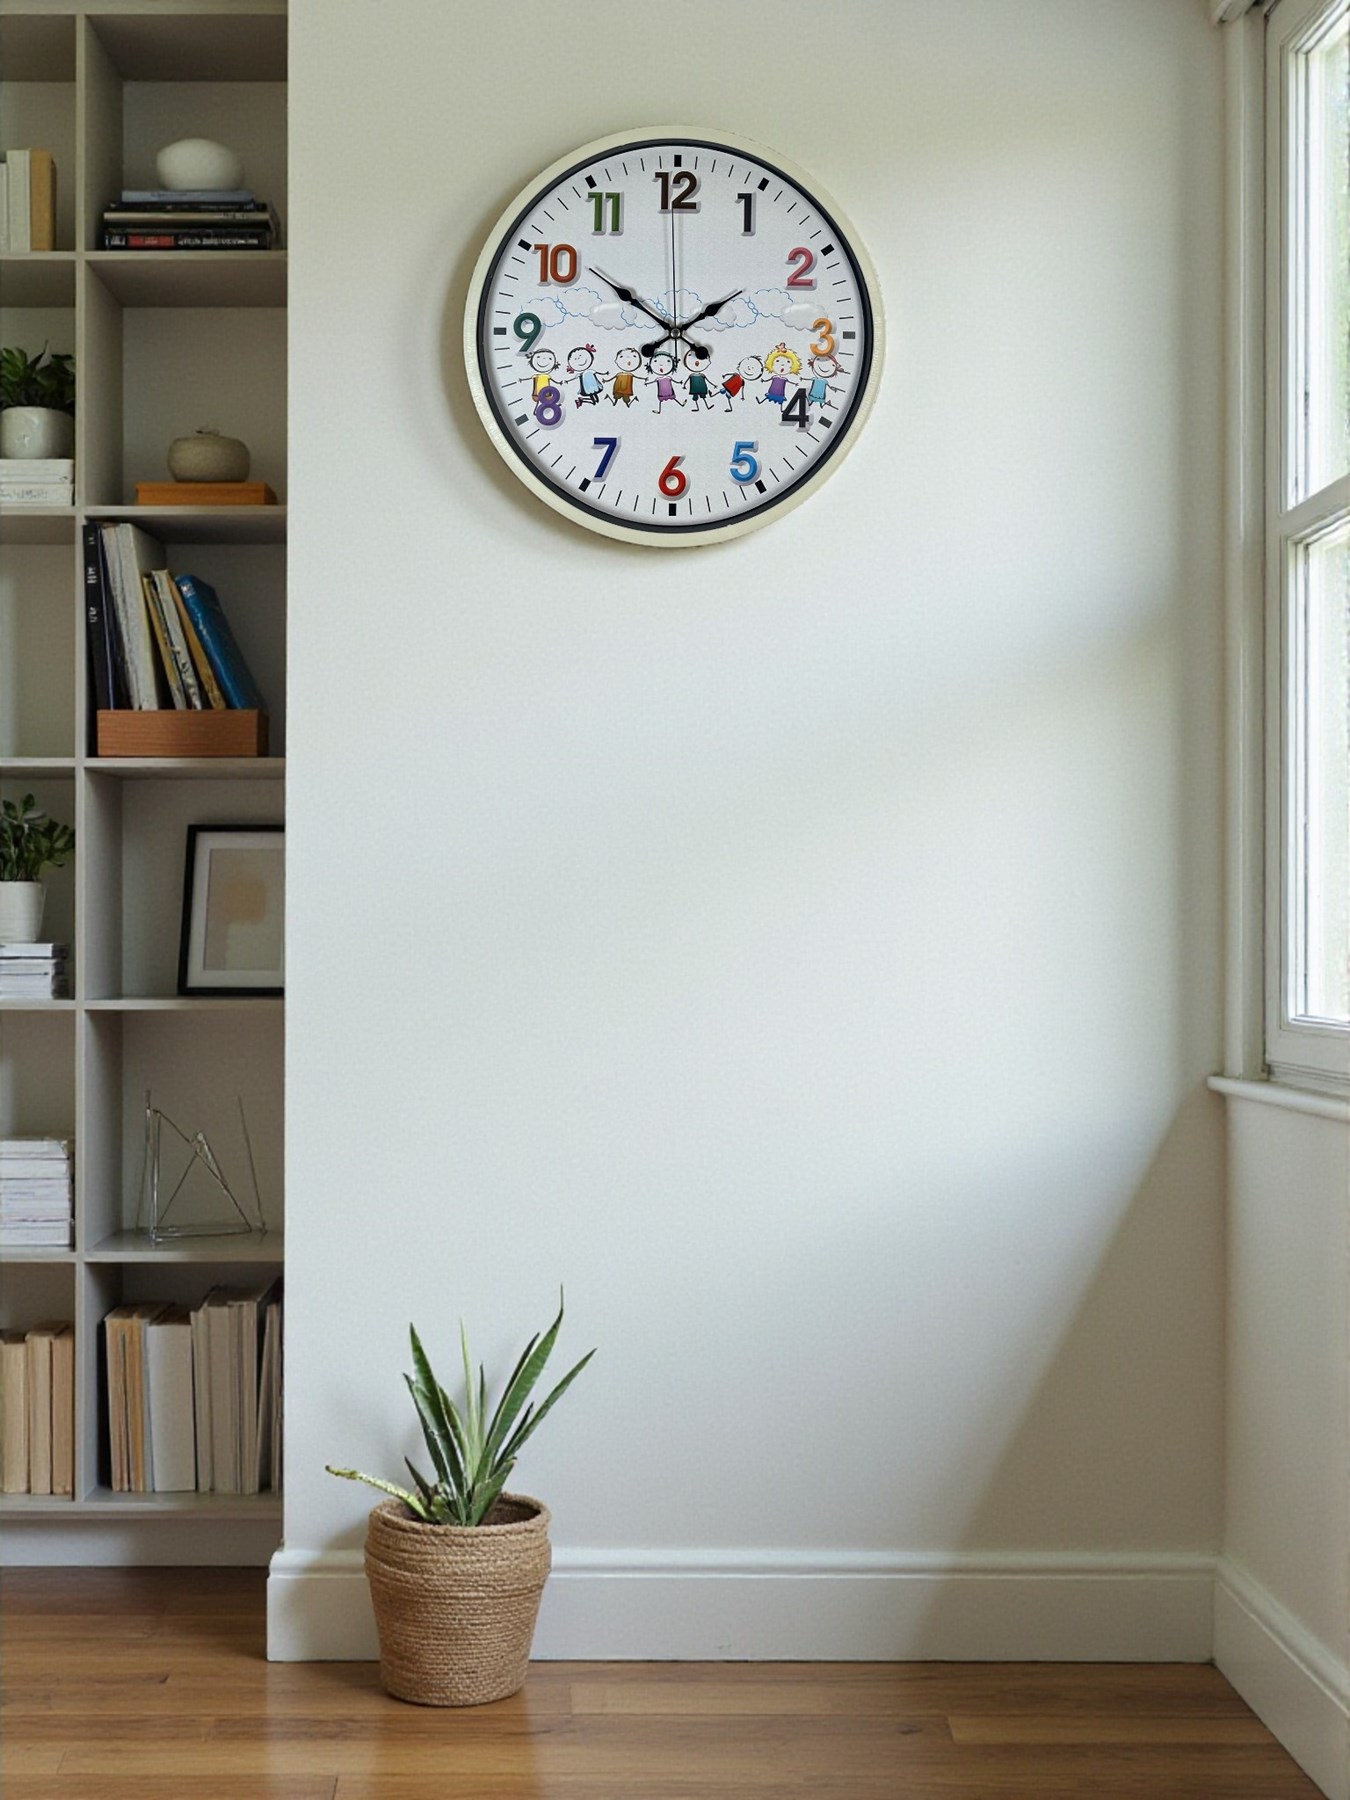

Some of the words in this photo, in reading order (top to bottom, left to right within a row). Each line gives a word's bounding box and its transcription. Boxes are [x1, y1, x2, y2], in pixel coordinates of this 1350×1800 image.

[655, 171, 698, 211] 12
[587, 192, 621, 232] 11
[737, 192, 752, 233] 1
[533, 243, 578, 283] 10
[786, 247, 814, 286] 2
[513, 312, 542, 352] 9
[810, 317, 834, 356] 3
[536, 386, 562, 426] 8
[781, 388, 809, 428] 4
[593, 437, 617, 478] 7
[658, 456, 685, 497] 6
[729, 441, 758, 482] 5
